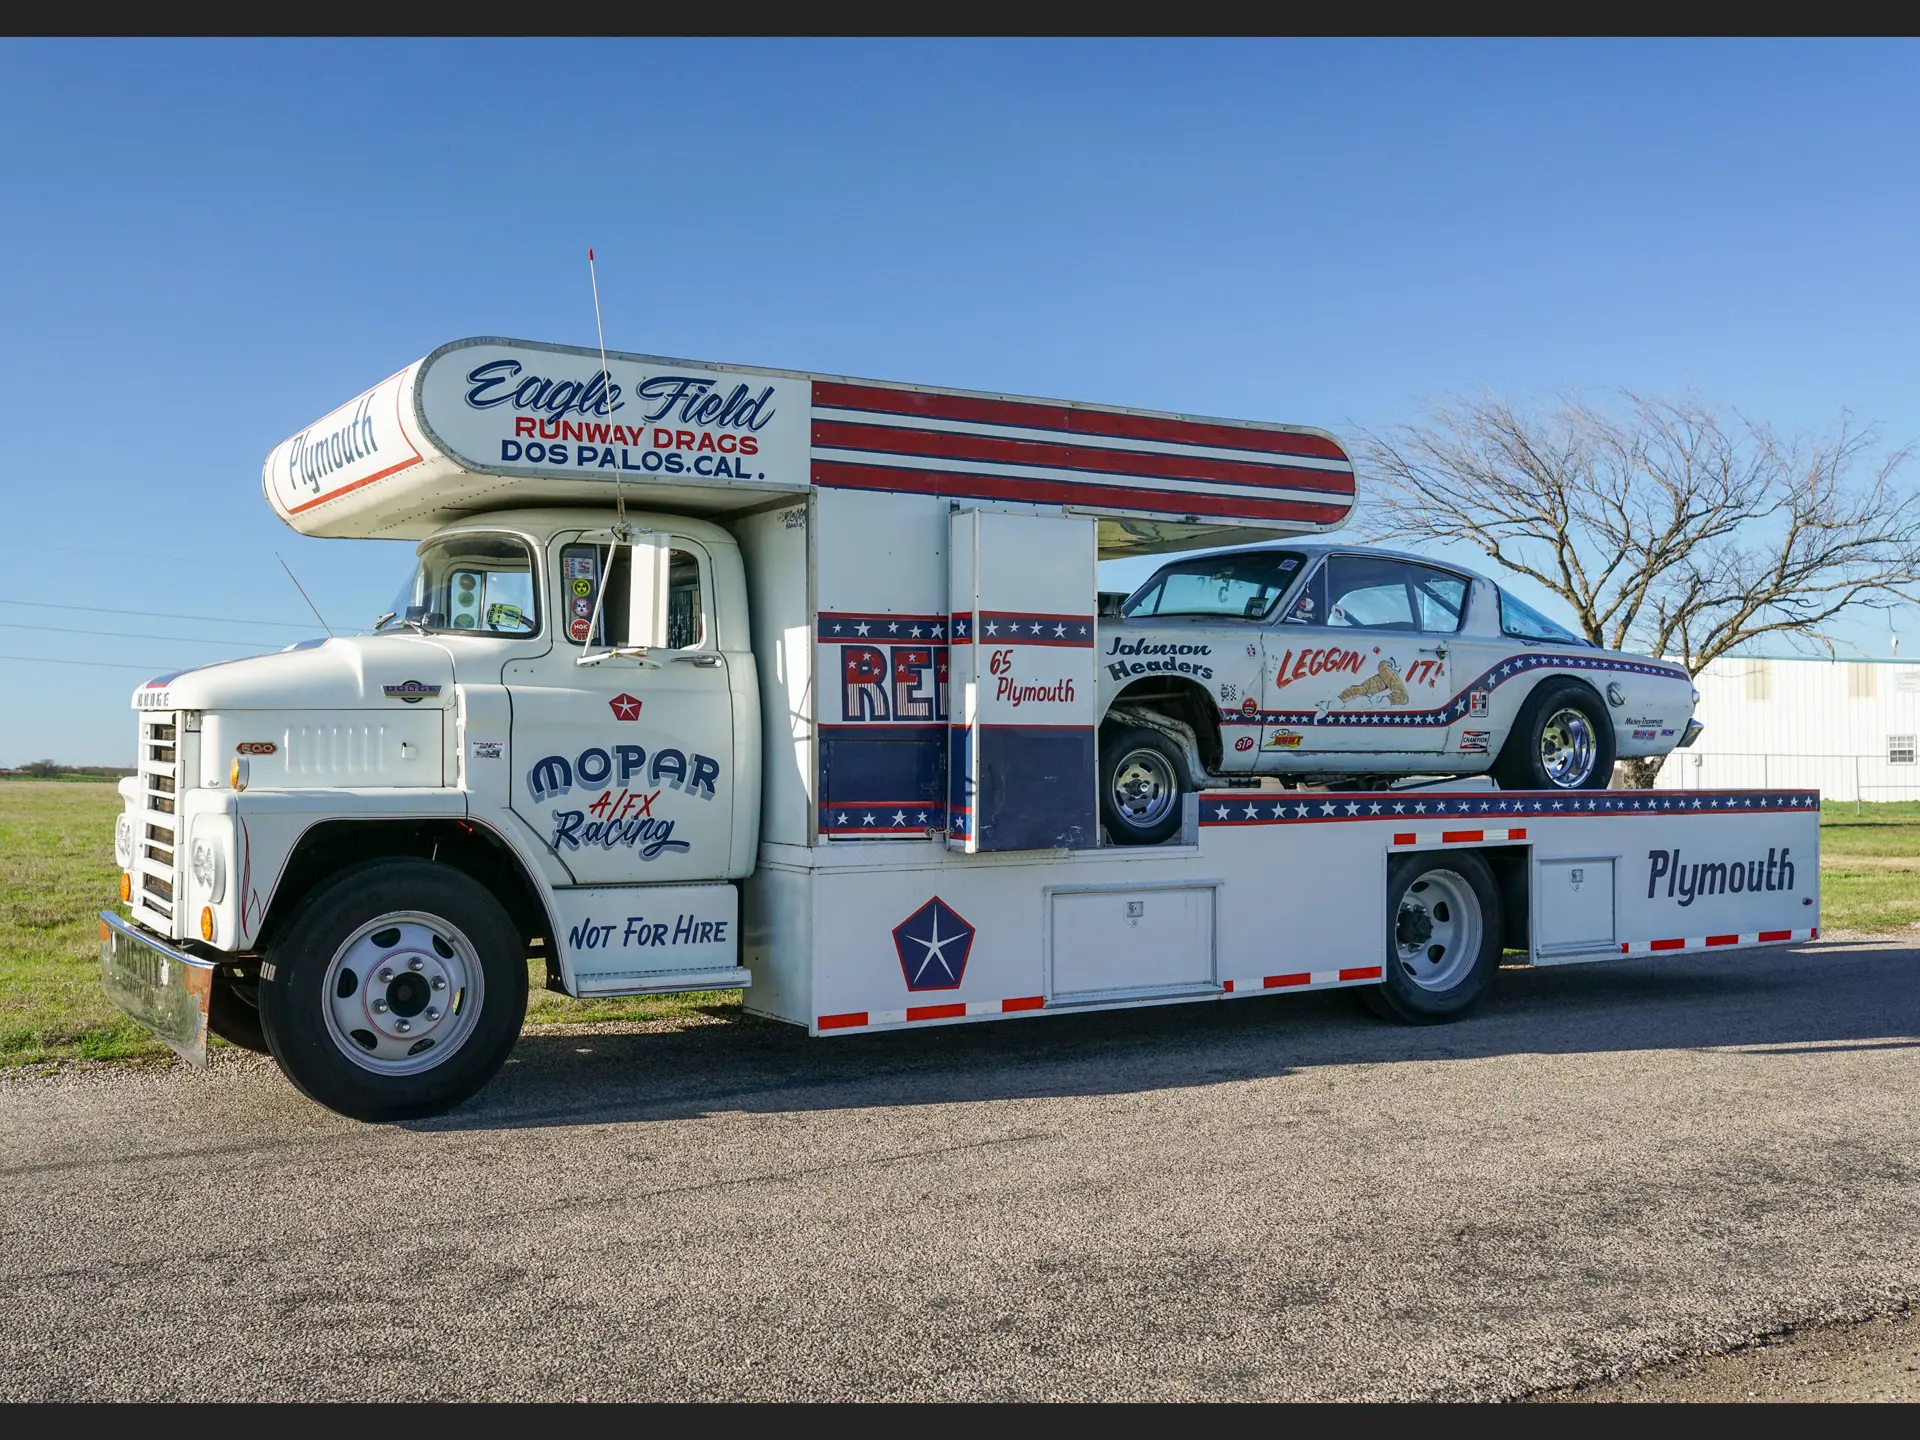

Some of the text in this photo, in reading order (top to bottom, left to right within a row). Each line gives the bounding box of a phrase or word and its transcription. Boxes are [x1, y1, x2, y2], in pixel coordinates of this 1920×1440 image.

[465, 360, 776, 433] Eagle Field
[289, 391, 379, 494] Plymouth
[515, 416, 759, 456] RUNWAY DRAGS
[501, 439, 569, 465] DOS
[1105, 636, 1212, 656] Johnson
[990, 649, 1014, 675] 65
[1104, 656, 1214, 682] Headers
[1404, 660, 1444, 689] IT!
[136, 692, 170, 707] DODGE
[996, 677, 1075, 708] Plymouth
[241, 744, 274, 753] 500
[1236, 737, 1253, 750] STP
[527, 744, 720, 802] MOPAR
[589, 788, 661, 822] A/FX
[552, 810, 691, 860] Racing
[1647, 847, 1795, 908] Plymouth
[569, 914, 729, 951] NOT FOR HIRE
